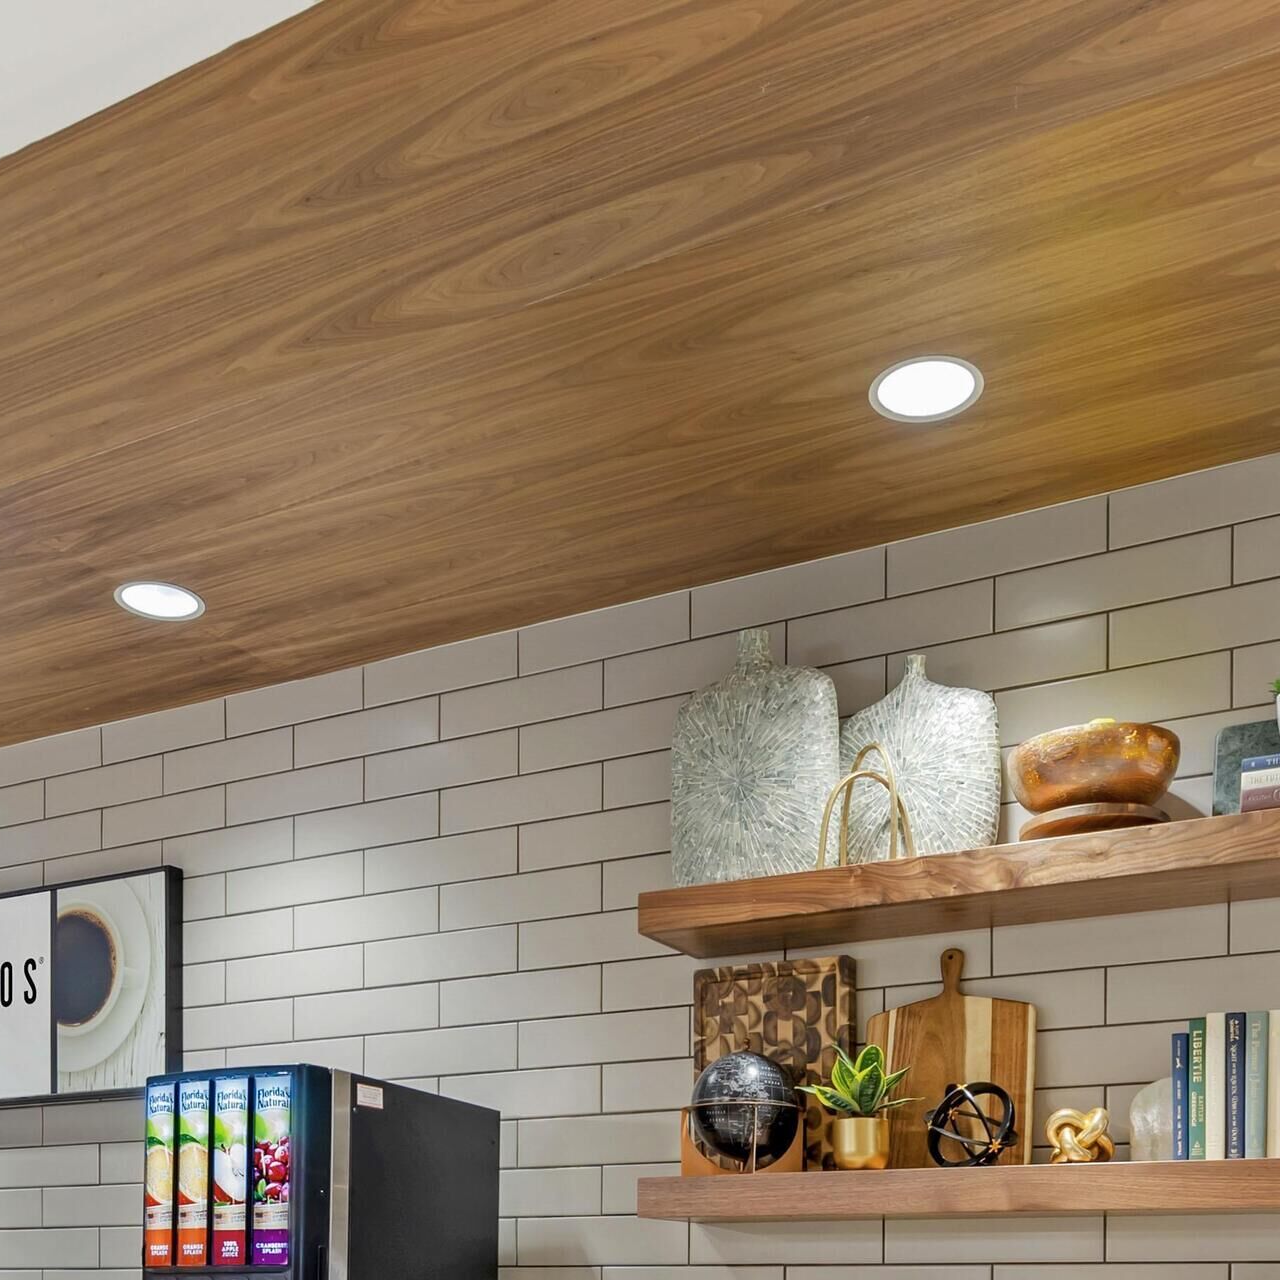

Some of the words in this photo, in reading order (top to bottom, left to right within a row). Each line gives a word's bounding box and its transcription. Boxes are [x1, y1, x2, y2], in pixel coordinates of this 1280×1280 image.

[1193, 1030, 1203, 1083] LIBERTIE
[182, 1100, 207, 1112] Natural
[217, 1100, 246, 1112] Natural
[258, 1098, 289, 1110] Natural
